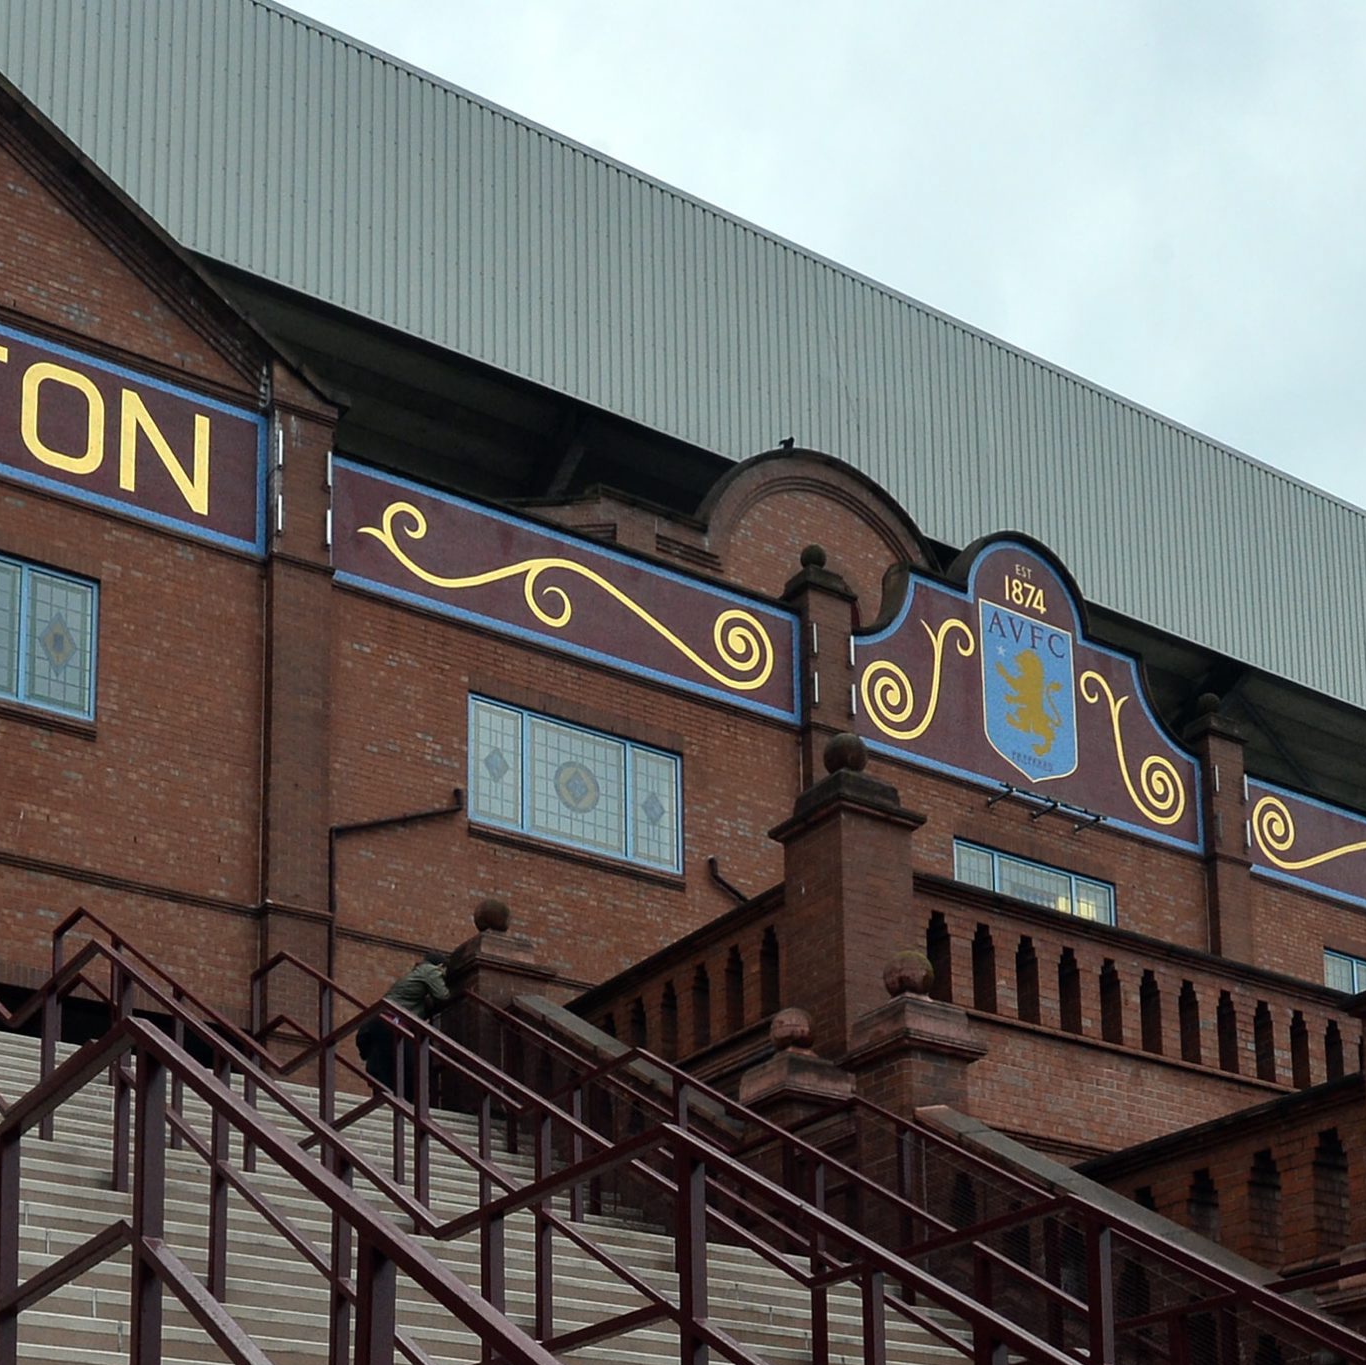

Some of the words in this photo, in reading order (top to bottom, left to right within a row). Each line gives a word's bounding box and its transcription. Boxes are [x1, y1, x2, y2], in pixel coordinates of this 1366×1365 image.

[1015, 563, 1032, 579] EST
[1005, 574, 1047, 615] 1874
[988, 610, 1065, 659] AVFC
